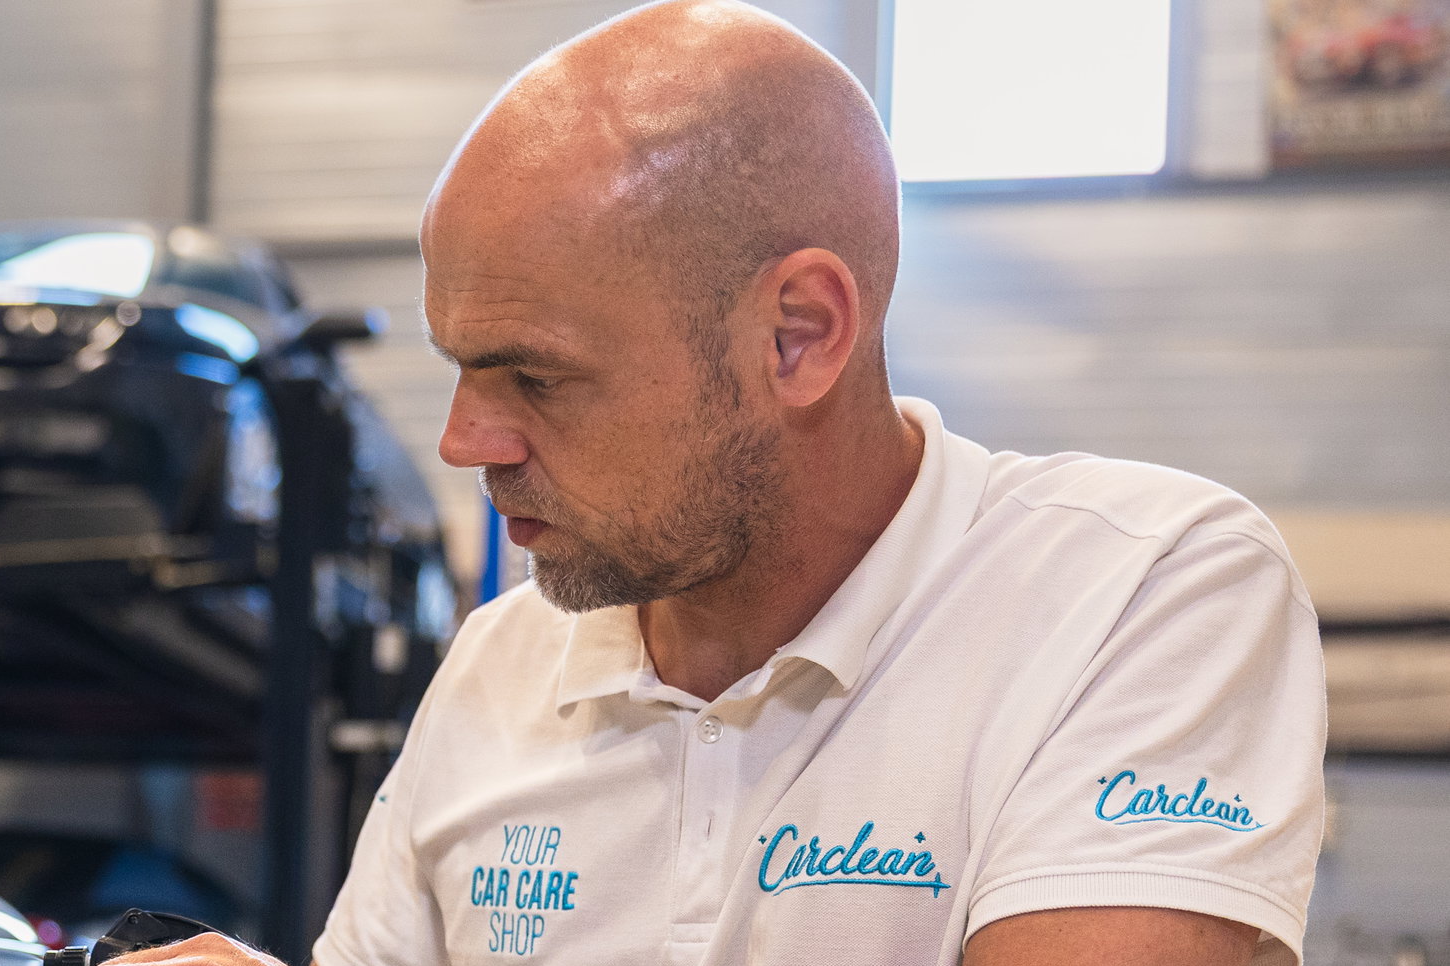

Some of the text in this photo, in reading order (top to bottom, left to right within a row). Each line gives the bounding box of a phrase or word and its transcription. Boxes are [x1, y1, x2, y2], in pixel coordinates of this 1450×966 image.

[1095, 770, 1253, 825] Carclean
[501, 825, 561, 865] YOUR
[758, 820, 936, 892] Carclean
[471, 866, 579, 911] CAR CARE
[489, 911, 545, 955] SHOP
